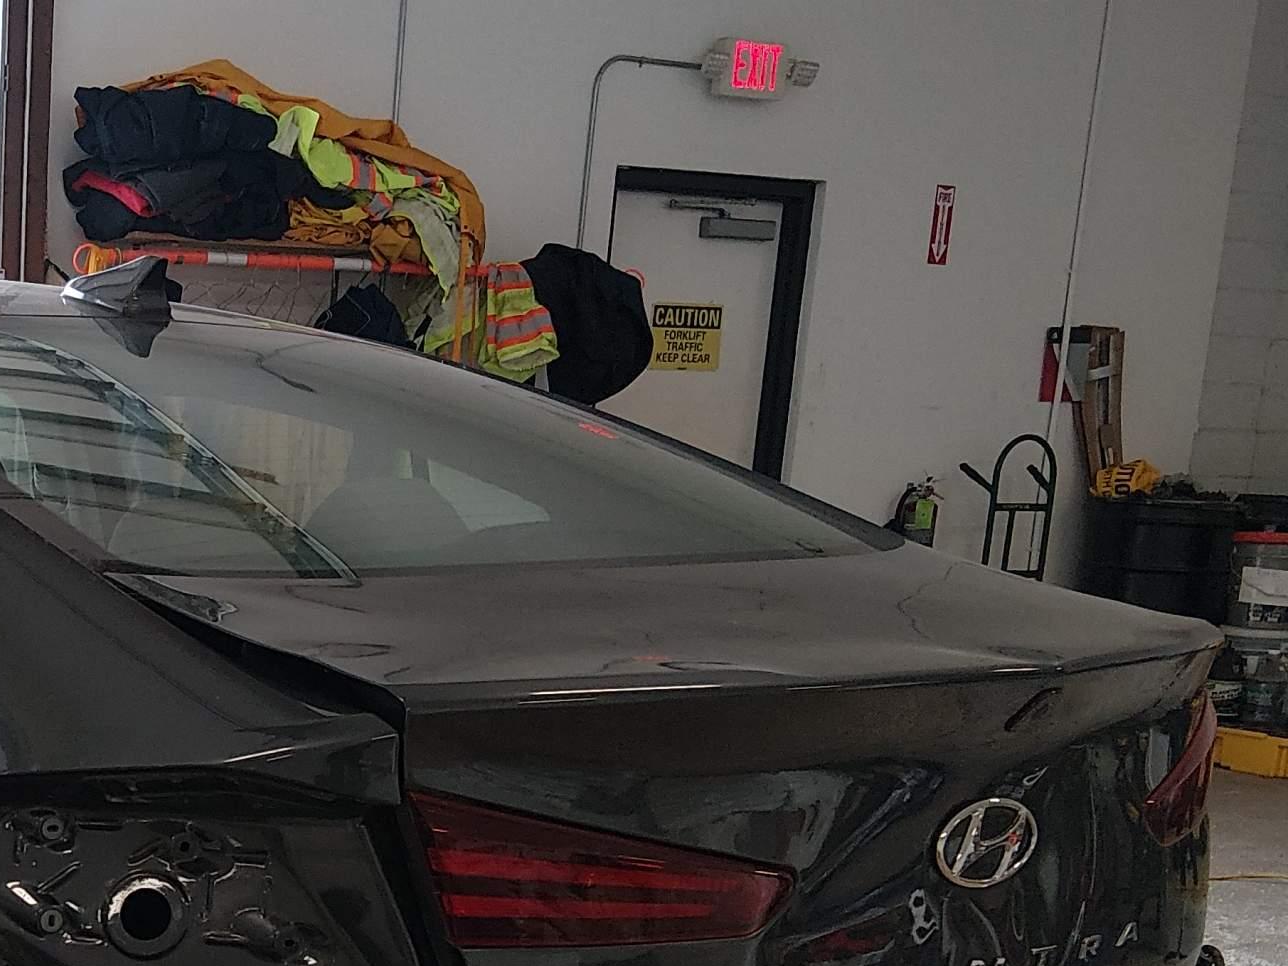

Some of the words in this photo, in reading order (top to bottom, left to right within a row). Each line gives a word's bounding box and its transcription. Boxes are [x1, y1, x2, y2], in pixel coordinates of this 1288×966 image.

[731, 39, 784, 92] EXIT
[655, 307, 720, 327] CAUTION
[664, 330, 707, 341] FORKLIFT
[666, 341, 703, 352] TRAFFIC
[655, 352, 678, 363] KEEP
[680, 353, 710, 364] CLEAR
